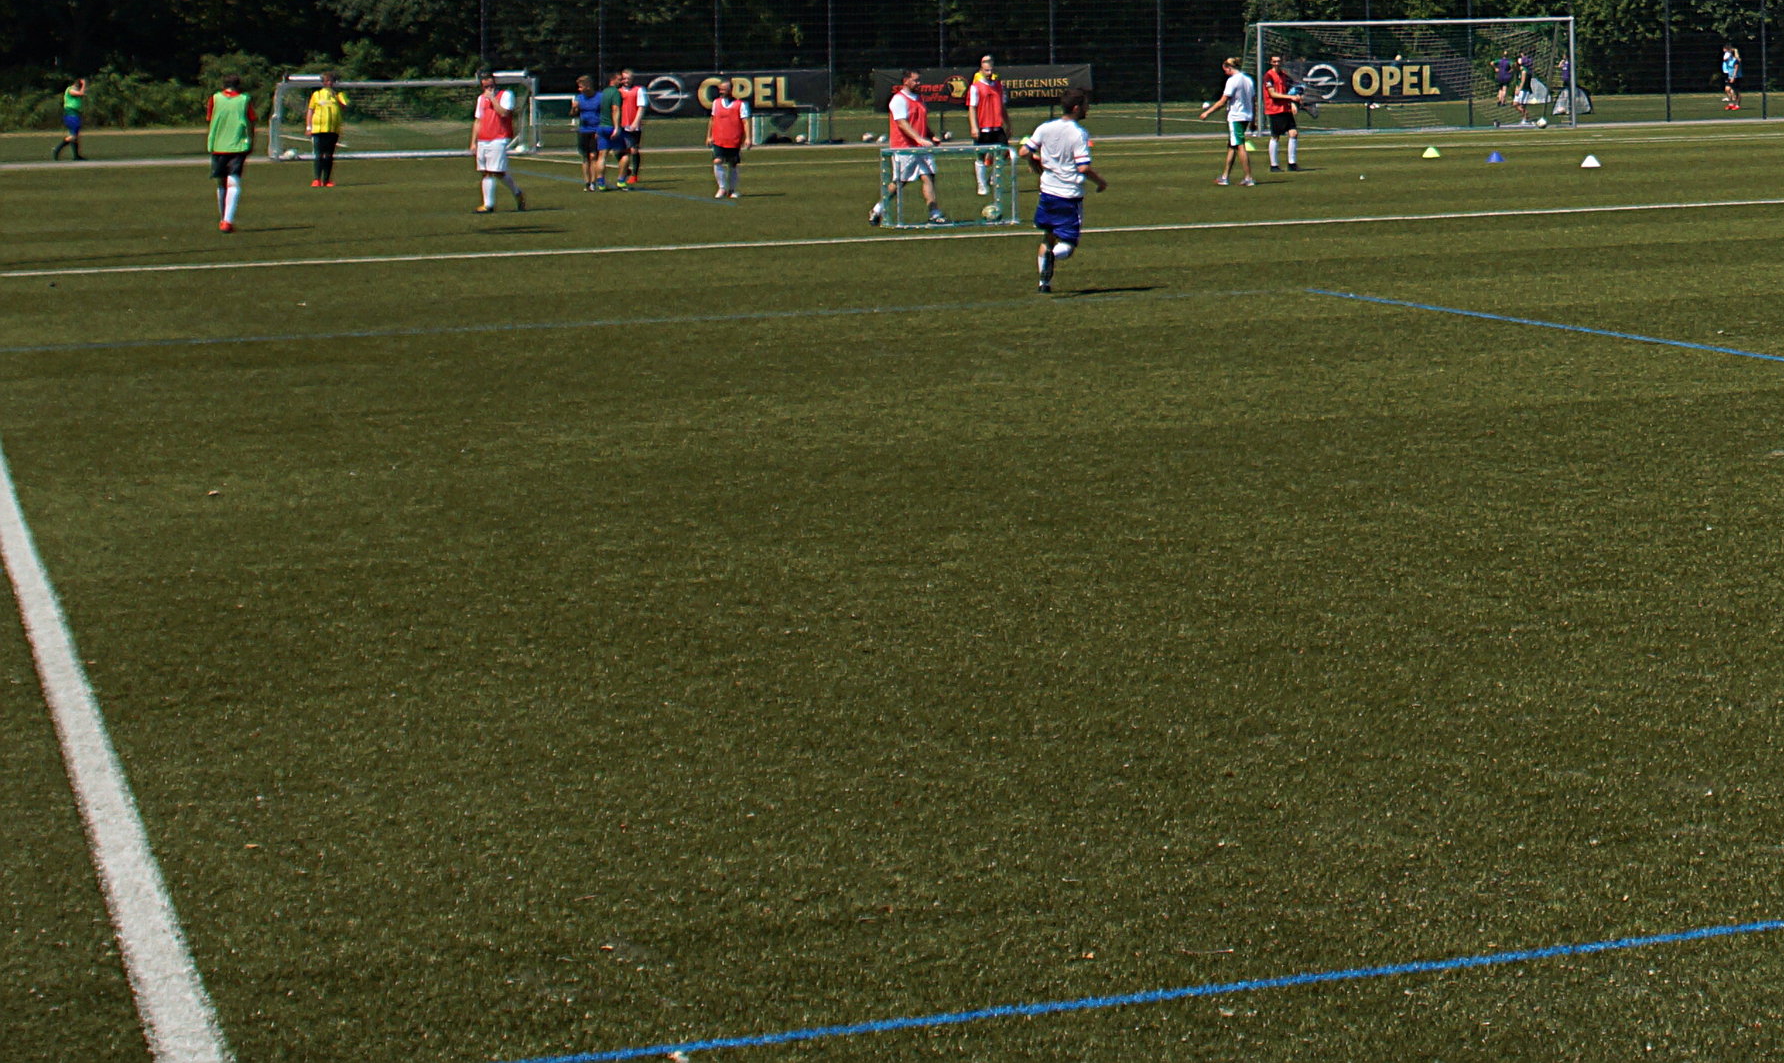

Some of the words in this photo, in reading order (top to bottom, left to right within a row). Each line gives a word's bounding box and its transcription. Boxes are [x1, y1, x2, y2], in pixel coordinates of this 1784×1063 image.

[697, 76, 796, 109] OPEL
[1010, 89, 1065, 99] DORTMUN
[1352, 65, 1441, 97] OPEL
